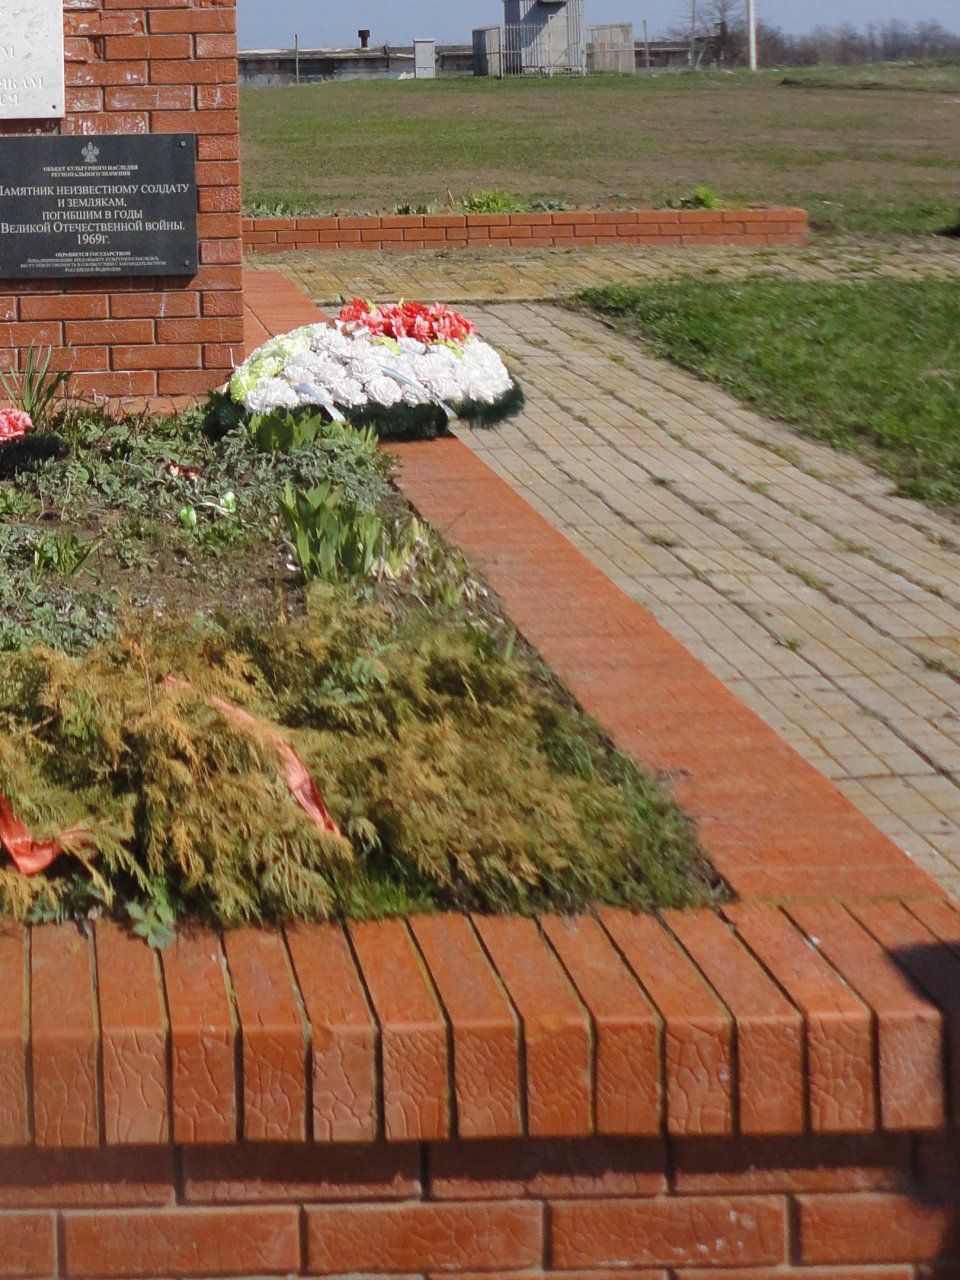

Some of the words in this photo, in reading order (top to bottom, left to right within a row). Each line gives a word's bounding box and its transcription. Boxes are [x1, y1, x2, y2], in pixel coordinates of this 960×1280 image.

[57, 184, 139, 195] НЕИЗВЕСТНОМУ
[141, 184, 189, 194] СОЛДАТУ
[57, 199, 65, 207] И
[67, 198, 127, 207] ЗЕМЛЯКАМ,
[42, 211, 103, 220] ПОГИБШИМ
[105, 210, 112, 219] В
[114, 210, 143, 219] ГОДЫ
[1, 222, 51, 233] ВЕЛИКОЙ
[53, 221, 143, 232] ОТЕЧЕСТВЕННОЙ
[145, 221, 185, 231] ВОЙНЫ.
[76, 235, 110, 245] 1969г.
